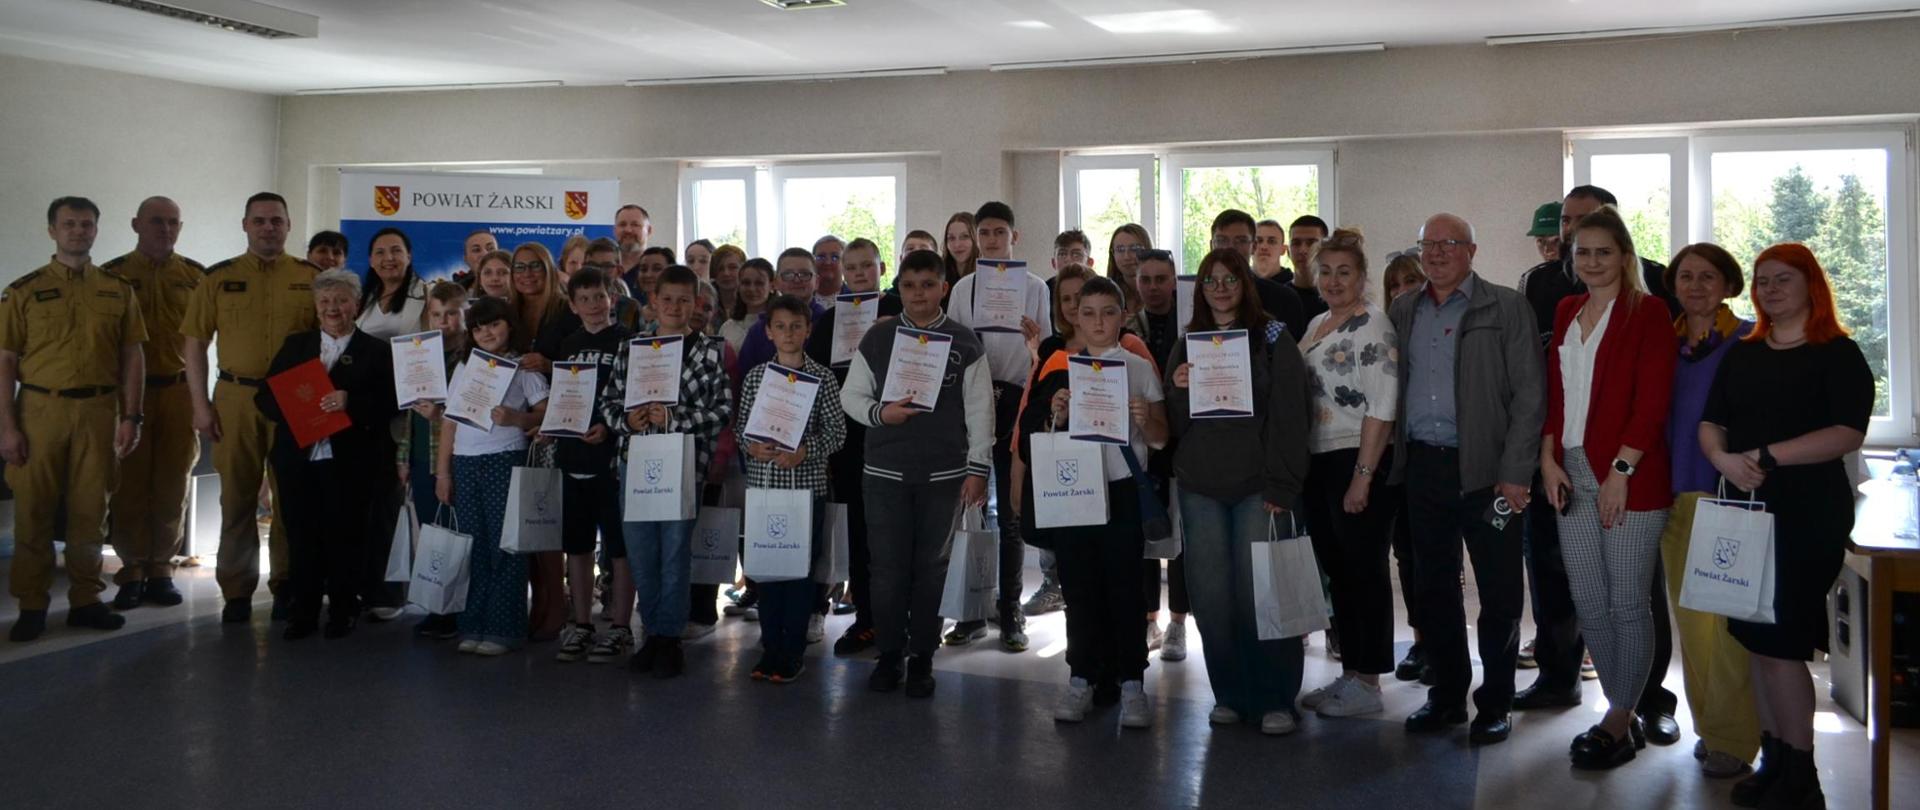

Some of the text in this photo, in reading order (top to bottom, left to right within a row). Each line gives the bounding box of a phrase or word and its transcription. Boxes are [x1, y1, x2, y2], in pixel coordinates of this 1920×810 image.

[412, 192, 554, 210] POWIAT ŻARSKI
[489, 225, 585, 237] www.powiatzary.pl
[1043, 488, 1095, 498] Powiat Żarski
[753, 541, 777, 549] Powiat
[1694, 567, 1750, 588] Powiat Żarski
